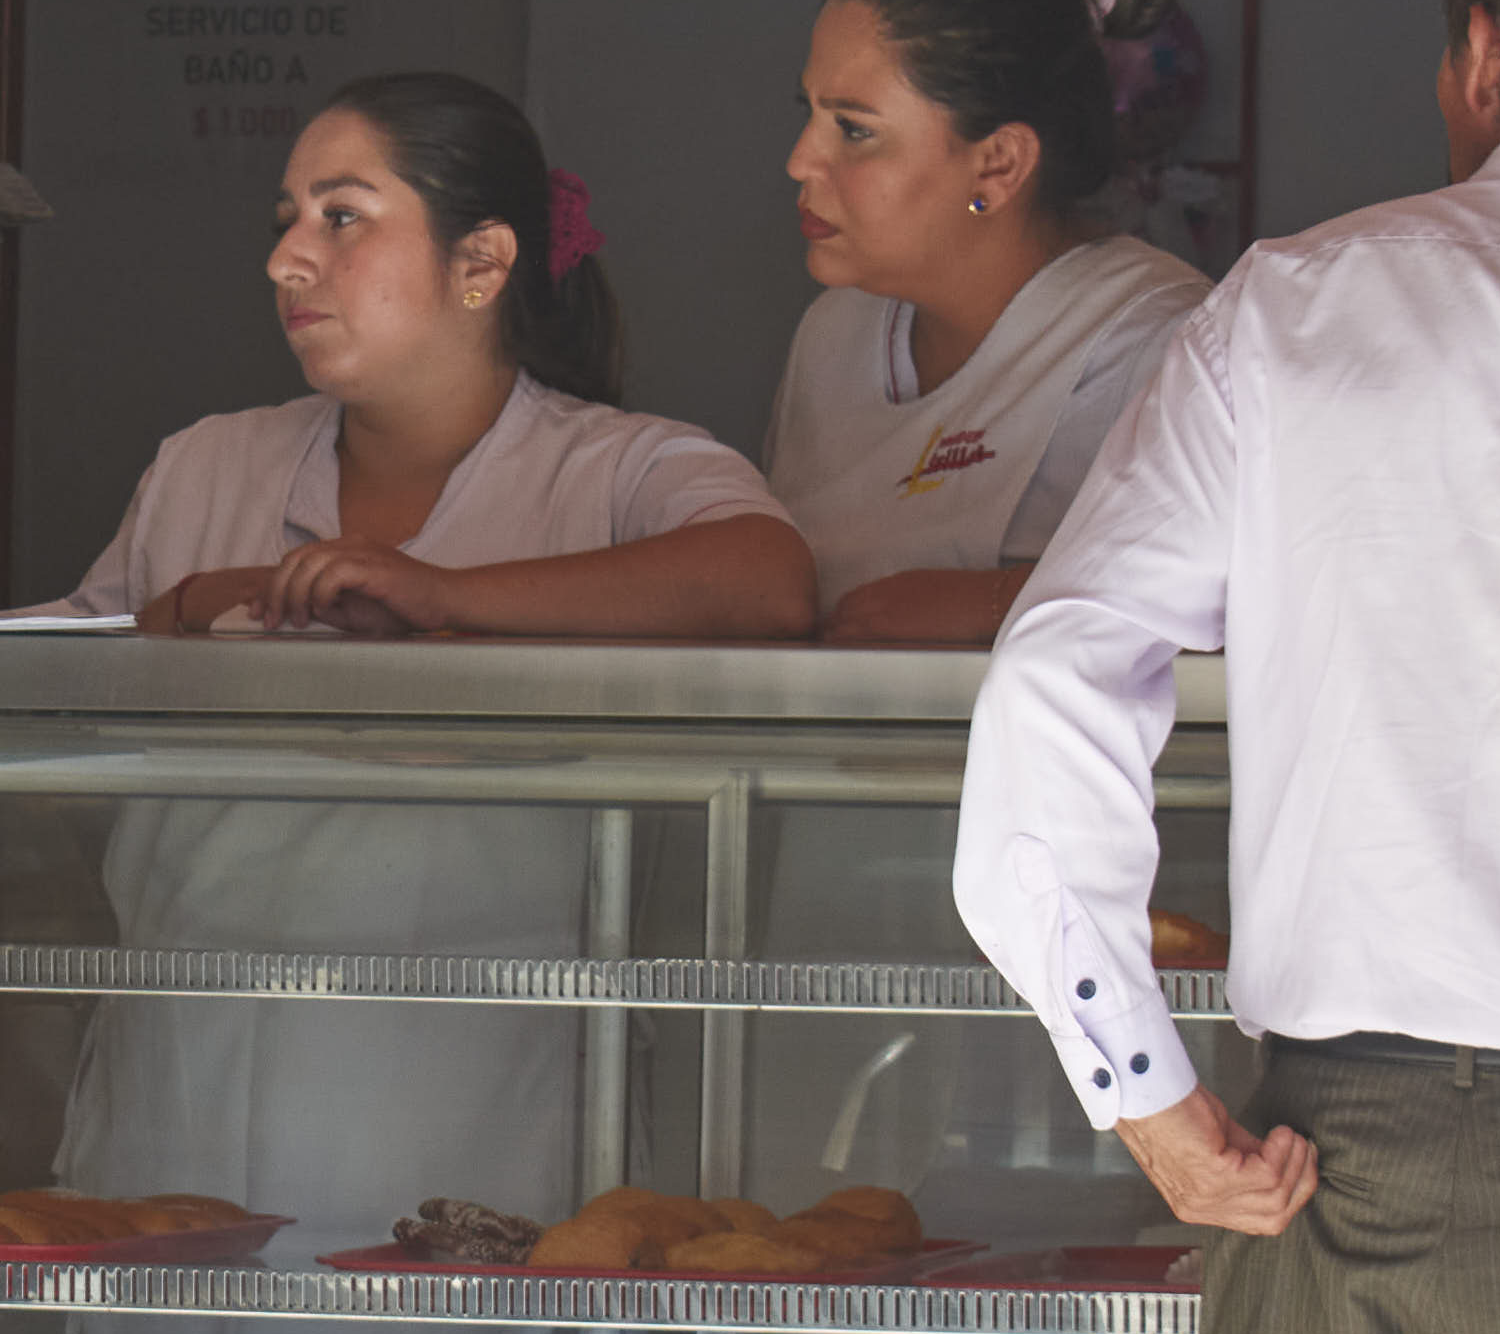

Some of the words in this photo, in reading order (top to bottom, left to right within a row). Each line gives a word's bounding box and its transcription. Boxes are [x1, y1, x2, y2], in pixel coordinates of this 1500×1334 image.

[145, 5, 293, 37] SERVICIO
[303, 5, 348, 37] DE
[183, 47, 274, 85] BAÑO
[285, 54, 309, 85] A
